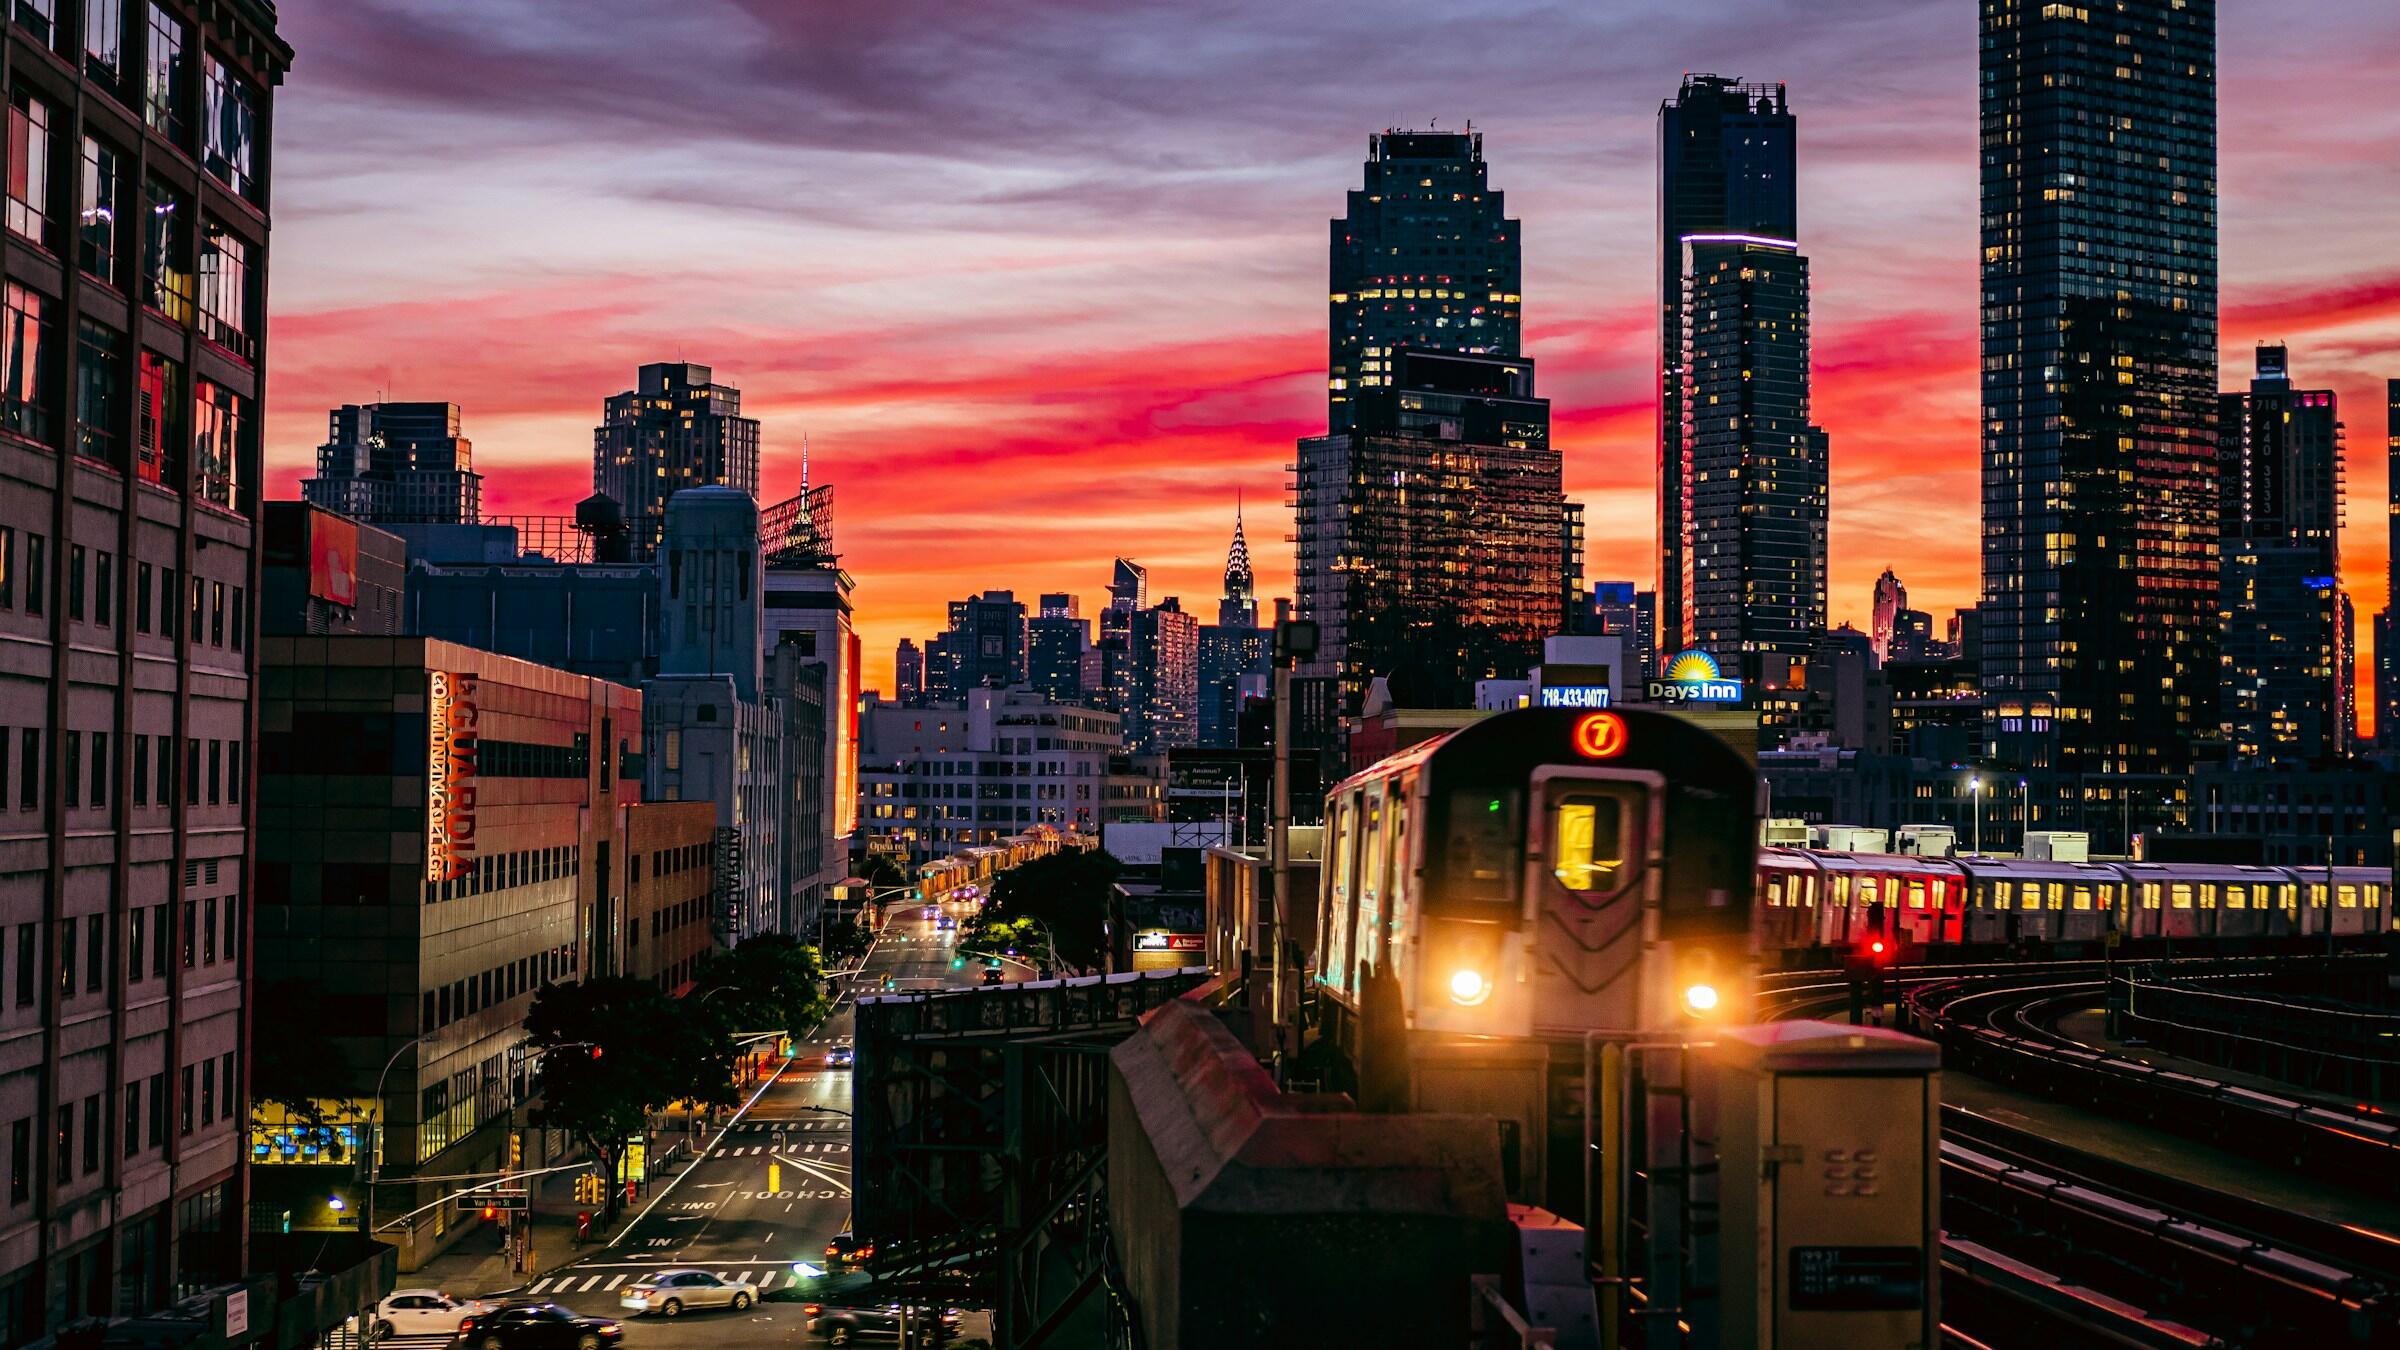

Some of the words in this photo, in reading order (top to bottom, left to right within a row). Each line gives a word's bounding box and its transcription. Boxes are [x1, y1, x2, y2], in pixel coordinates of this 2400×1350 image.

[2257, 400, 2278, 410] 718
[2219, 437, 2239, 447] ENT
[2220, 450, 2240, 460] OW
[1542, 688, 1609, 707] 718-433-0077
[1649, 682, 1700, 701] Days
[1702, 682, 1737, 699] Inn
[1592, 722, 1612, 747] 7
[446, 672, 478, 881] LAGUARDIA
[428, 794, 447, 881] COLLEGE
[474, 1199, 486, 1207] Van
[503, 1199, 510, 1207] St
[740, 1190, 851, 1201] SCHOOL
